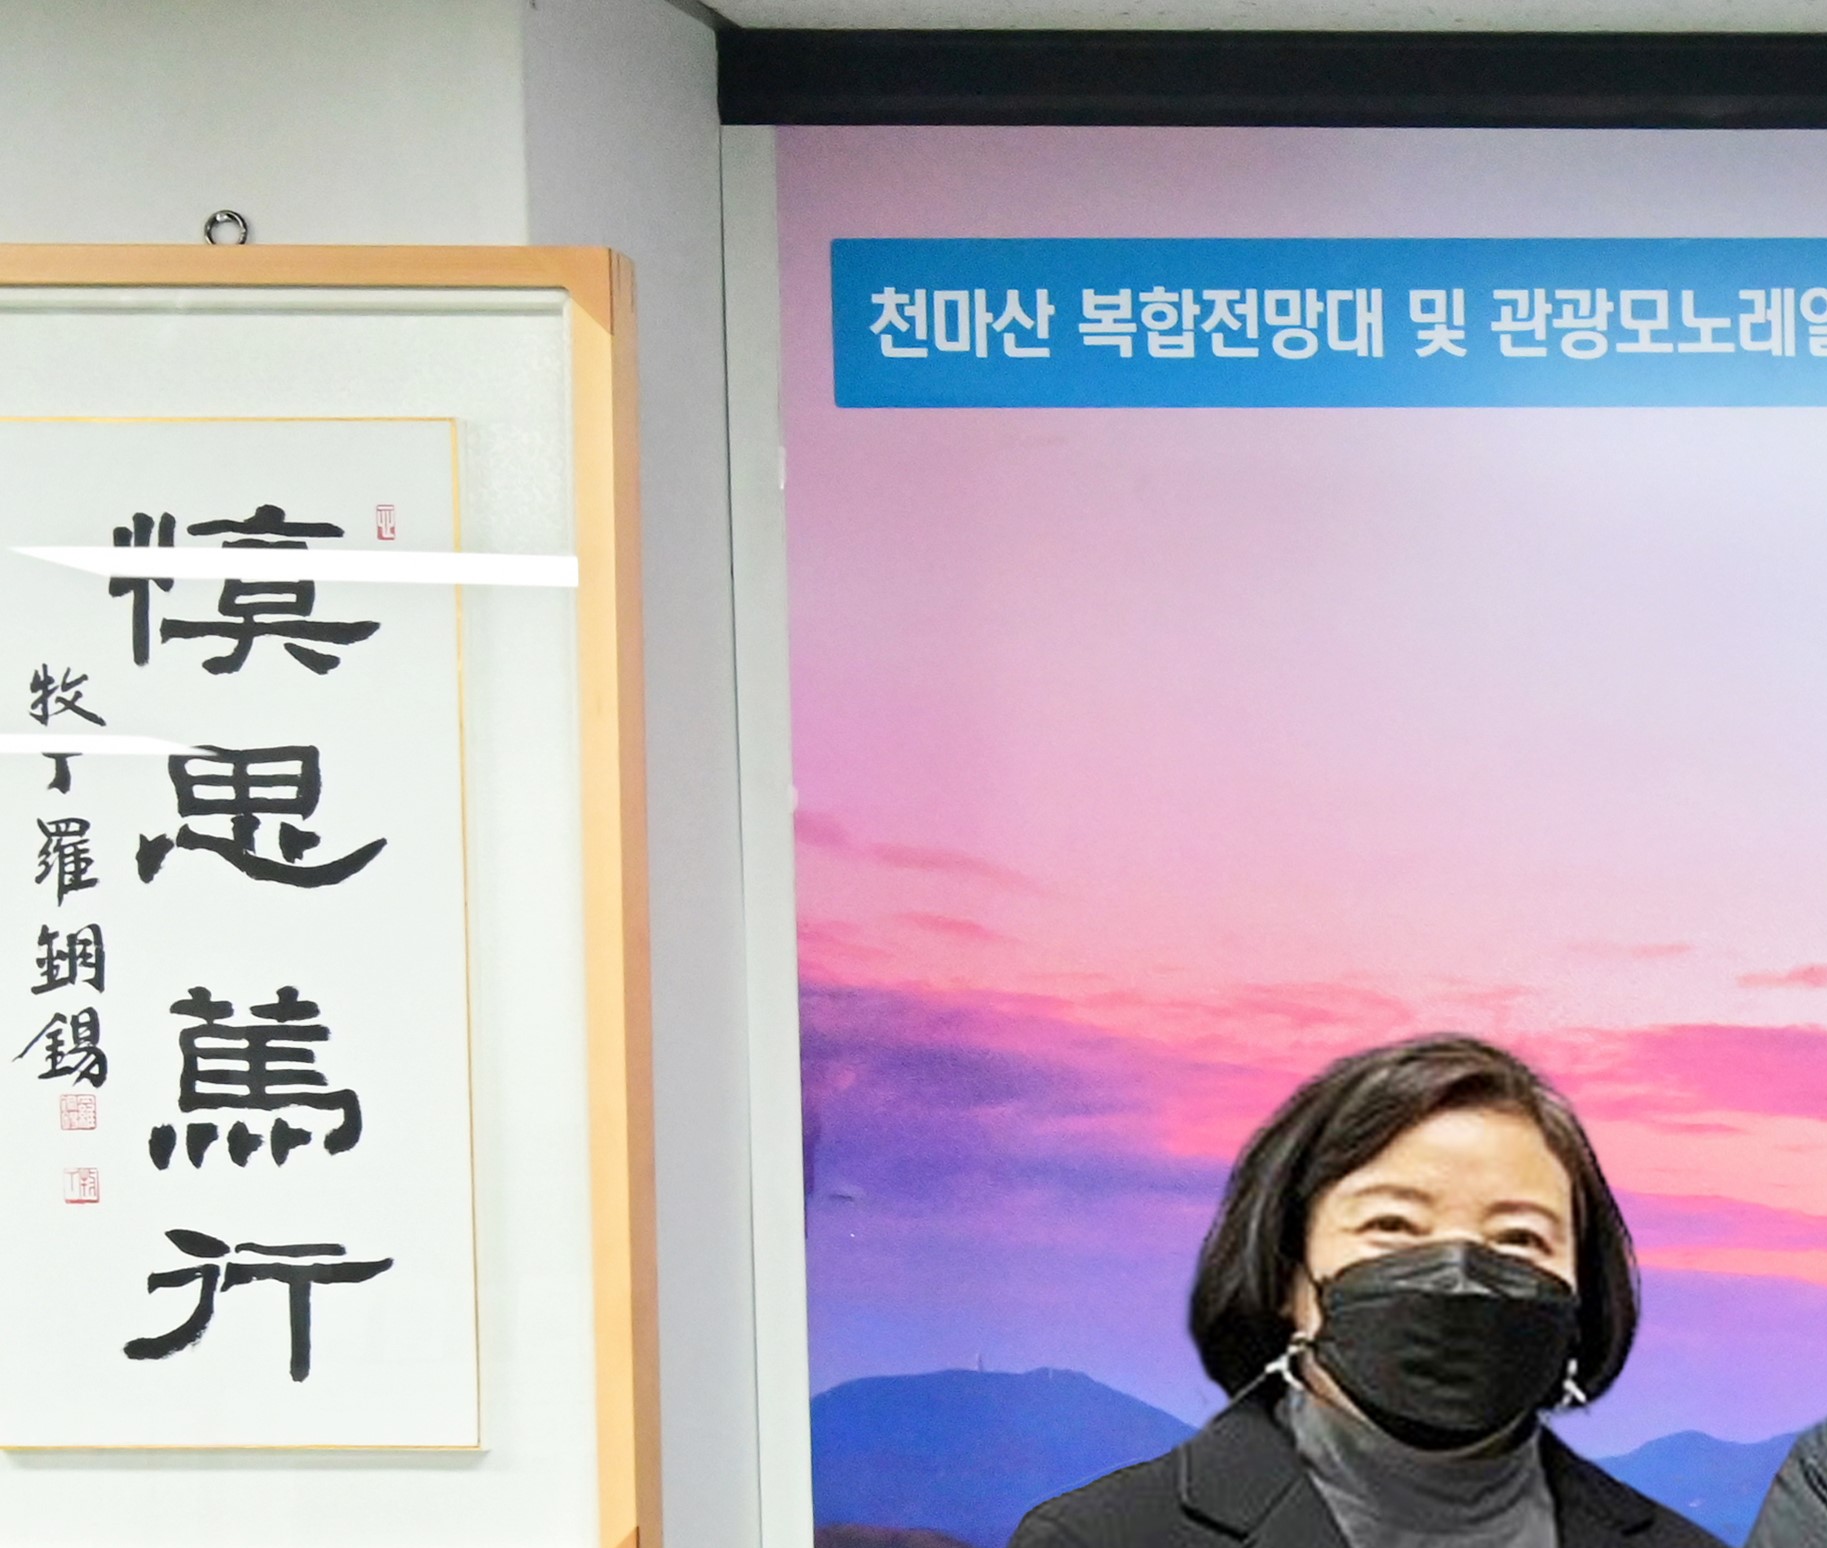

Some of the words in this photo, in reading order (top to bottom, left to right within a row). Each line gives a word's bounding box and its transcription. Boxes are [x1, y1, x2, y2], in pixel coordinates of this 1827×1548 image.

[870, 286, 1055, 358] 천마산
[1079, 286, 1383, 359] 복합전망대
[1410, 288, 1467, 357] 및
